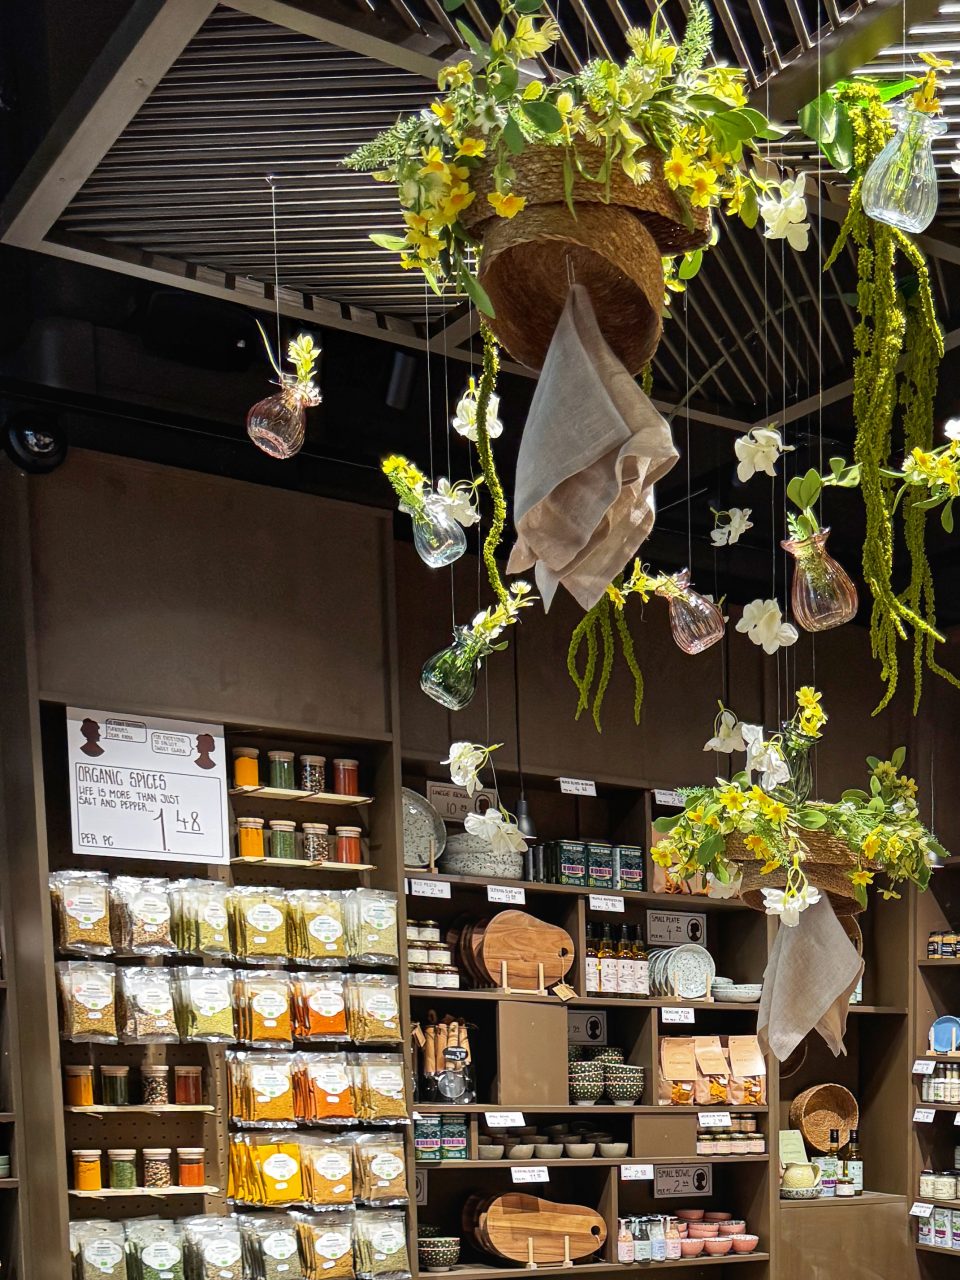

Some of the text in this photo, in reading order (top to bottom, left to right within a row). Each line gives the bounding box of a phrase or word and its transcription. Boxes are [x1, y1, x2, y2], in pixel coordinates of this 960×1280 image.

[78, 766, 167, 791] ORGANIC SPICES
[79, 786, 180, 805] LIFE IS MORE THAN JUST
[78, 797, 97, 806] SALT
[100, 799, 116, 808] AND
[176, 809, 201, 832] 48
[81, 833, 98, 845] PER
[665, 916, 681, 925] PLATE
[658, 1169, 692, 1178] SMALL BOWL
